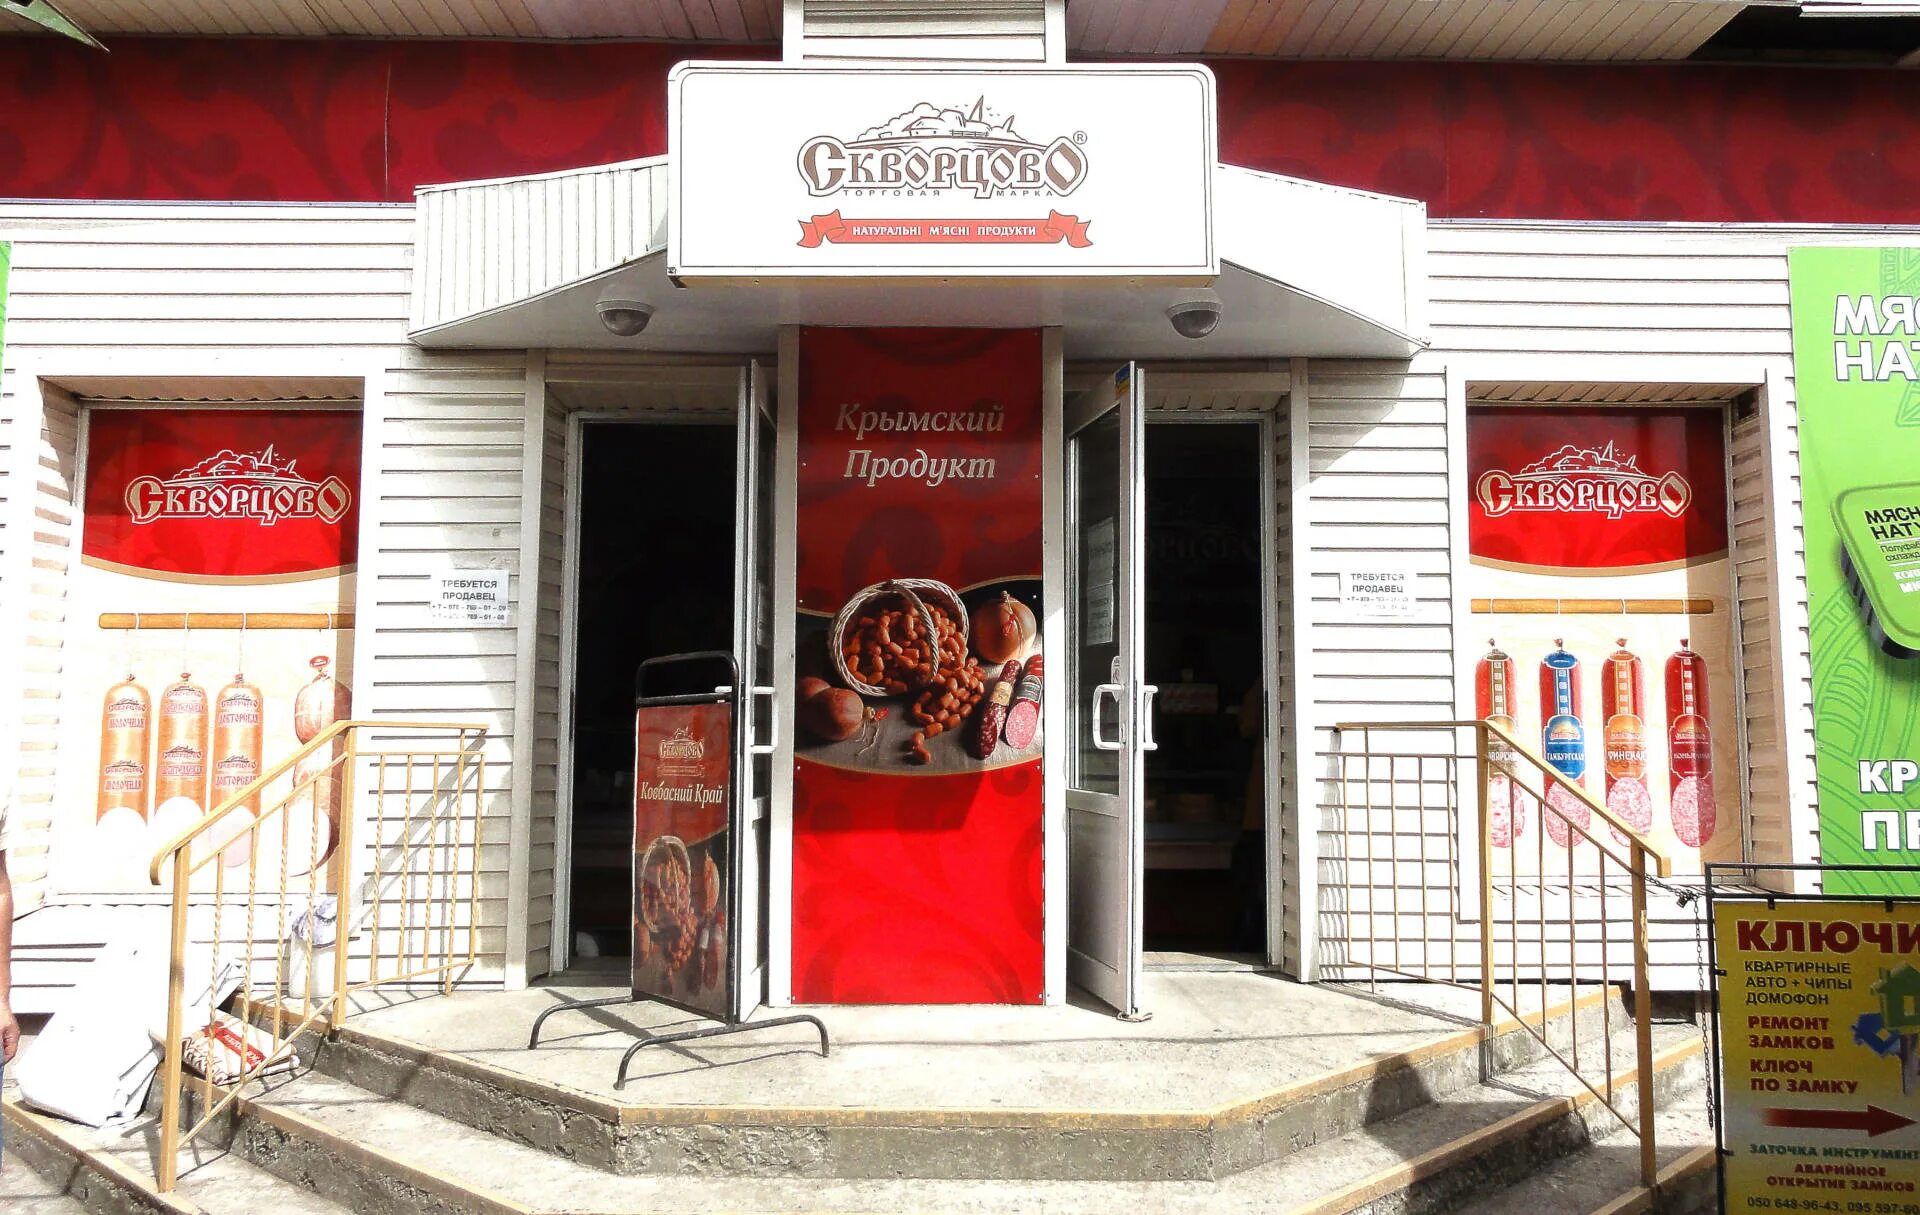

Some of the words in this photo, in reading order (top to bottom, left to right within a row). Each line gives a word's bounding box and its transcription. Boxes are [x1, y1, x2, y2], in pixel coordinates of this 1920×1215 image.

[843, 189, 940, 197] ТОРГОВАЯ
[995, 189, 1054, 197] МАРКА
[852, 225, 922, 236] НАТУРАЛЬНІ
[929, 225, 970, 236] М'ЯСНІ
[977, 225, 1037, 236] ПРОДУКТИ
[1833, 294, 1920, 336] МЯ
[835, 402, 1005, 441] Крымский
[843, 448, 996, 487] Продукт
[442, 580, 497, 588] ТРЕБУЕТСЯ
[1351, 573, 1404, 581] ТРЕБУЕТСЯ
[443, 592, 496, 601] ПРОДАВЕЦ
[1352, 585, 1404, 594] ПРОДАВЕЦ
[641, 781, 693, 801] Ковбасний
[695, 783, 723, 808] Край
[1737, 920, 1920, 954] КЛЮЧИ
[1745, 961, 1852, 974] КВАРТИРНЫЕ
[1745, 976, 1787, 988] АВТО
[1805, 978, 1852, 990] ЧИПЫ
[1746, 992, 1829, 1005] ДОМОФОН
[1748, 1016, 1829, 1030] РЕМОНТ
[1749, 1035, 1835, 1050] ЗАМКОВ
[1751, 1059, 1813, 1073] КЛЮЧ
[1751, 1078, 1780, 1091] ПО
[1787, 1078, 1859, 1094] ЗАМКУ
[1750, 1144, 1817, 1157] ЗАТОЧКА
[1794, 1163, 1886, 1177] АВАРИЙНОЕ
[1767, 1176, 1846, 1189] ОТКРЫТИЕ
[1851, 1179, 1915, 1192] ЗАМКОВ
[1748, 1197, 1770, 1208] 050
